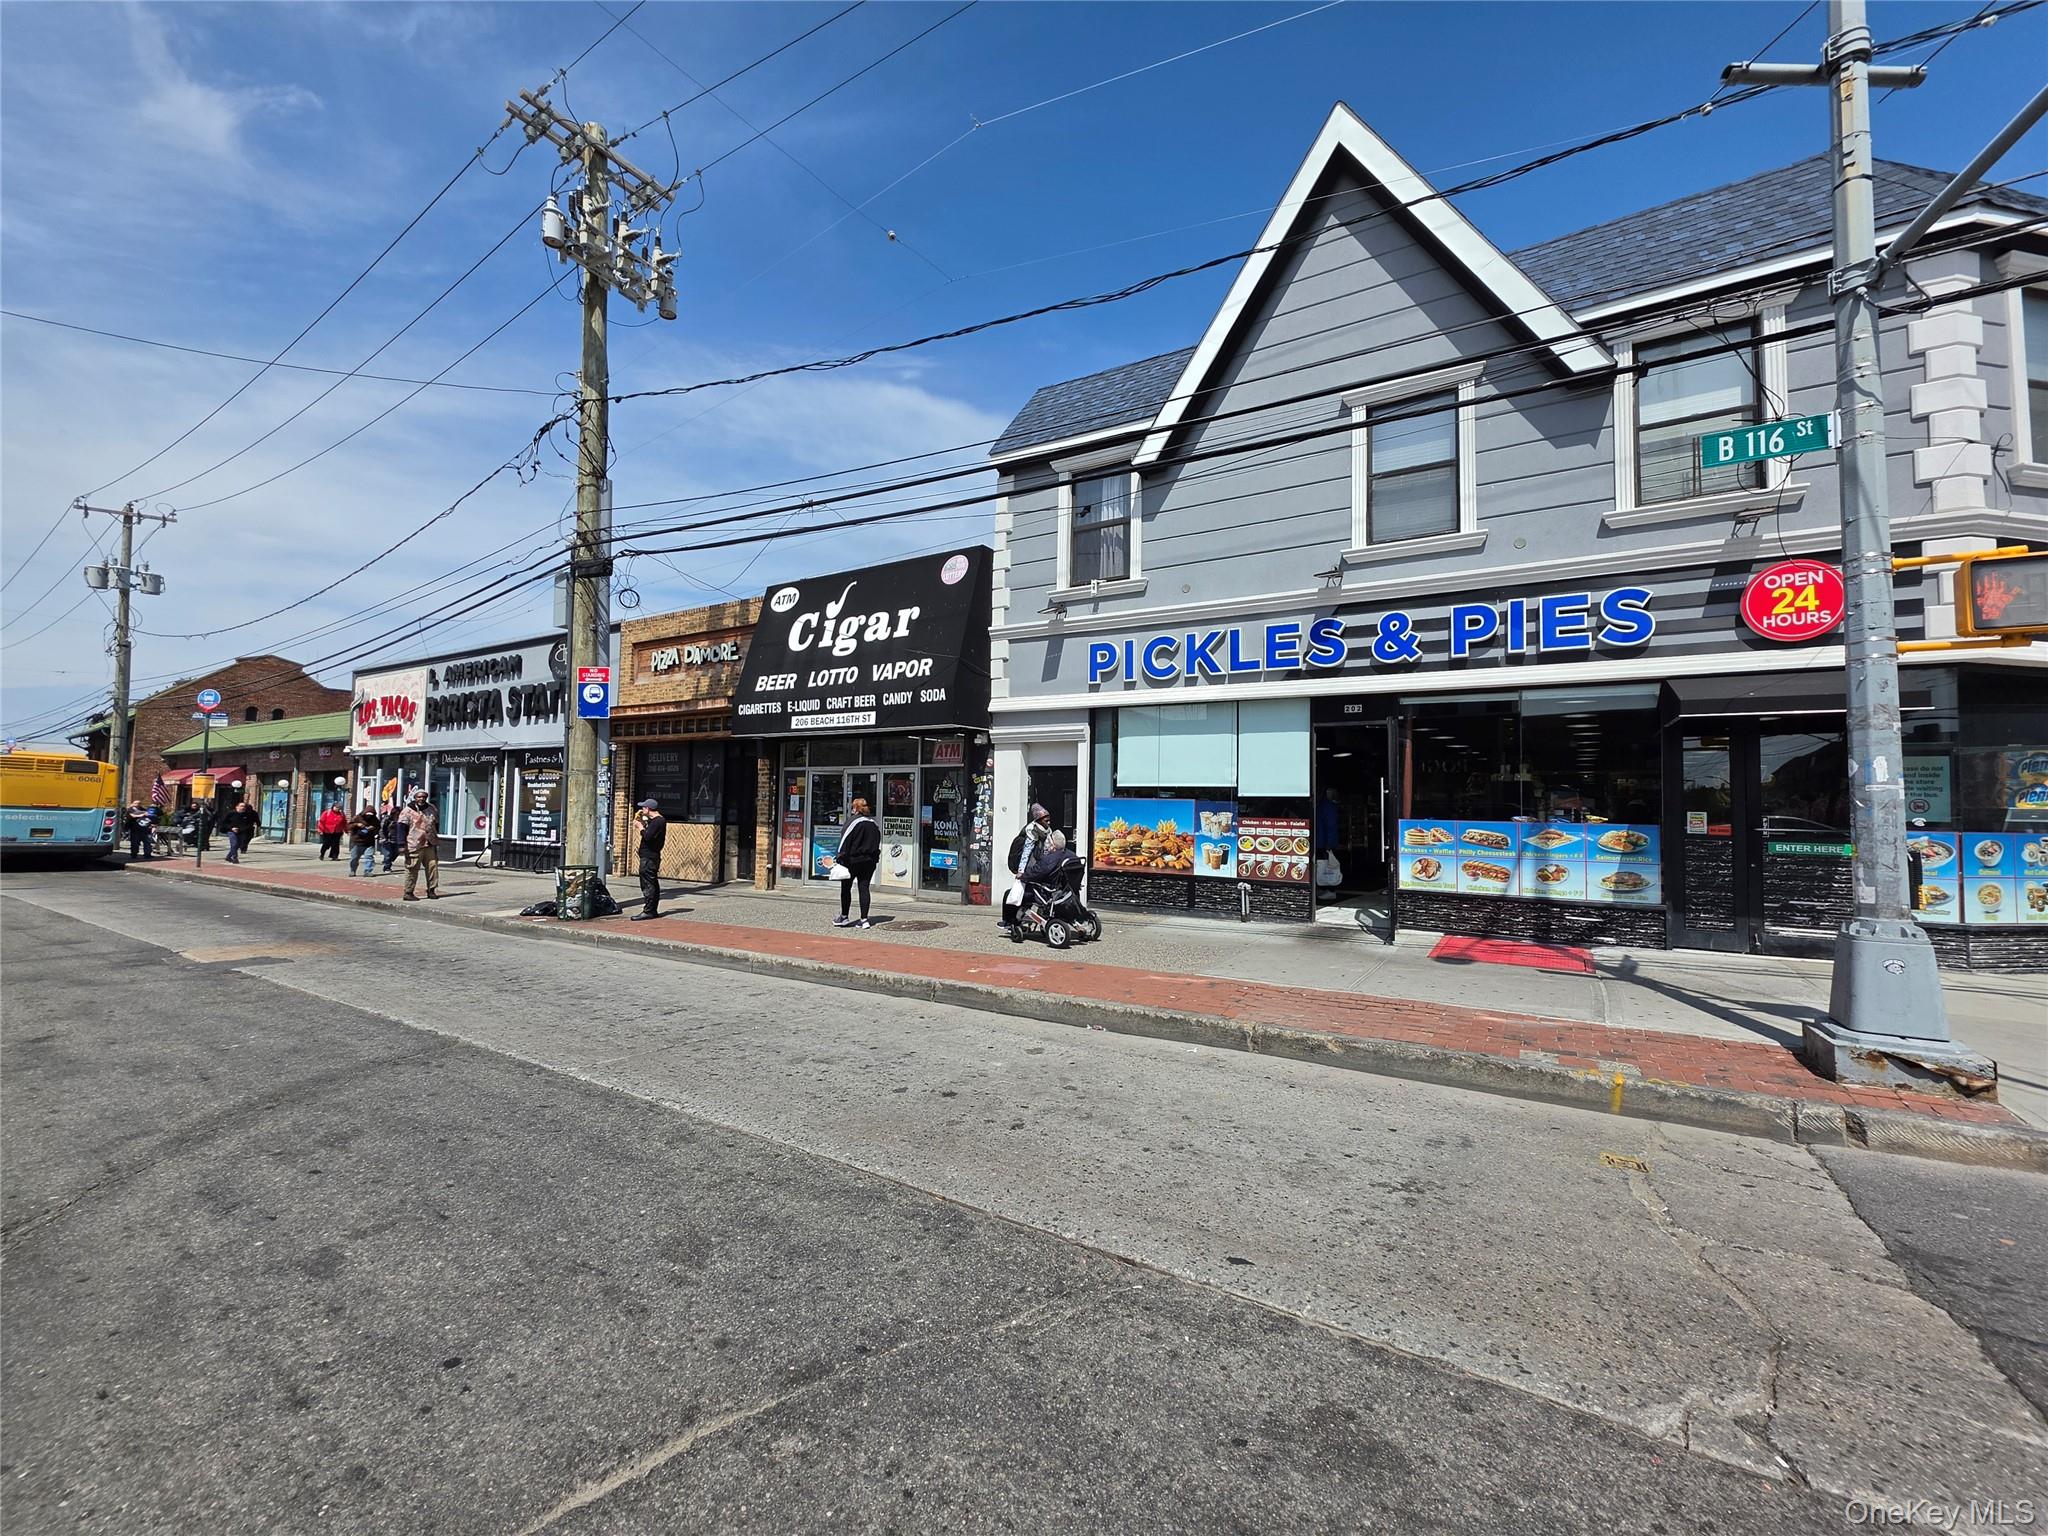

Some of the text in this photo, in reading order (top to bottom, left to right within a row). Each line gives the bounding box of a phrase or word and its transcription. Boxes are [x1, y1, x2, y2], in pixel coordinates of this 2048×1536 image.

[1718, 419, 1814, 462] B 116 St
[1763, 570, 1824, 589] OPEN
[774, 593, 797, 607] ATM
[1771, 584, 1820, 615] 24
[1762, 609, 1832, 628] HOURS
[788, 604, 921, 657] Cigar
[1088, 586, 1656, 684] PICKLES & PIES
[650, 647, 680, 672] PIZZA
[443, 654, 523, 686] AMERICAN
[755, 657, 933, 692] BEER LOTTO VAPOR
[358, 695, 417, 727] LOS TACOS
[425, 688, 504, 730] BARISTA
[738, 688, 946, 716] CIGARETTES E-LIQUID CRAFT BEER CANDY SODA
[1345, 705, 1362, 713] 202
[795, 713, 872, 727] 206 BEACH 116TH ST
[525, 752, 551, 765] Pastries
[648, 752, 679, 762] DELIVERY
[935, 744, 961, 758] ATM
[883, 823, 913, 831] LEMONADE
[934, 820, 959, 830] KONA
[1459, 848, 1517, 857] Philly Cheesesteak
[1775, 844, 1843, 853] ENTER HERE
